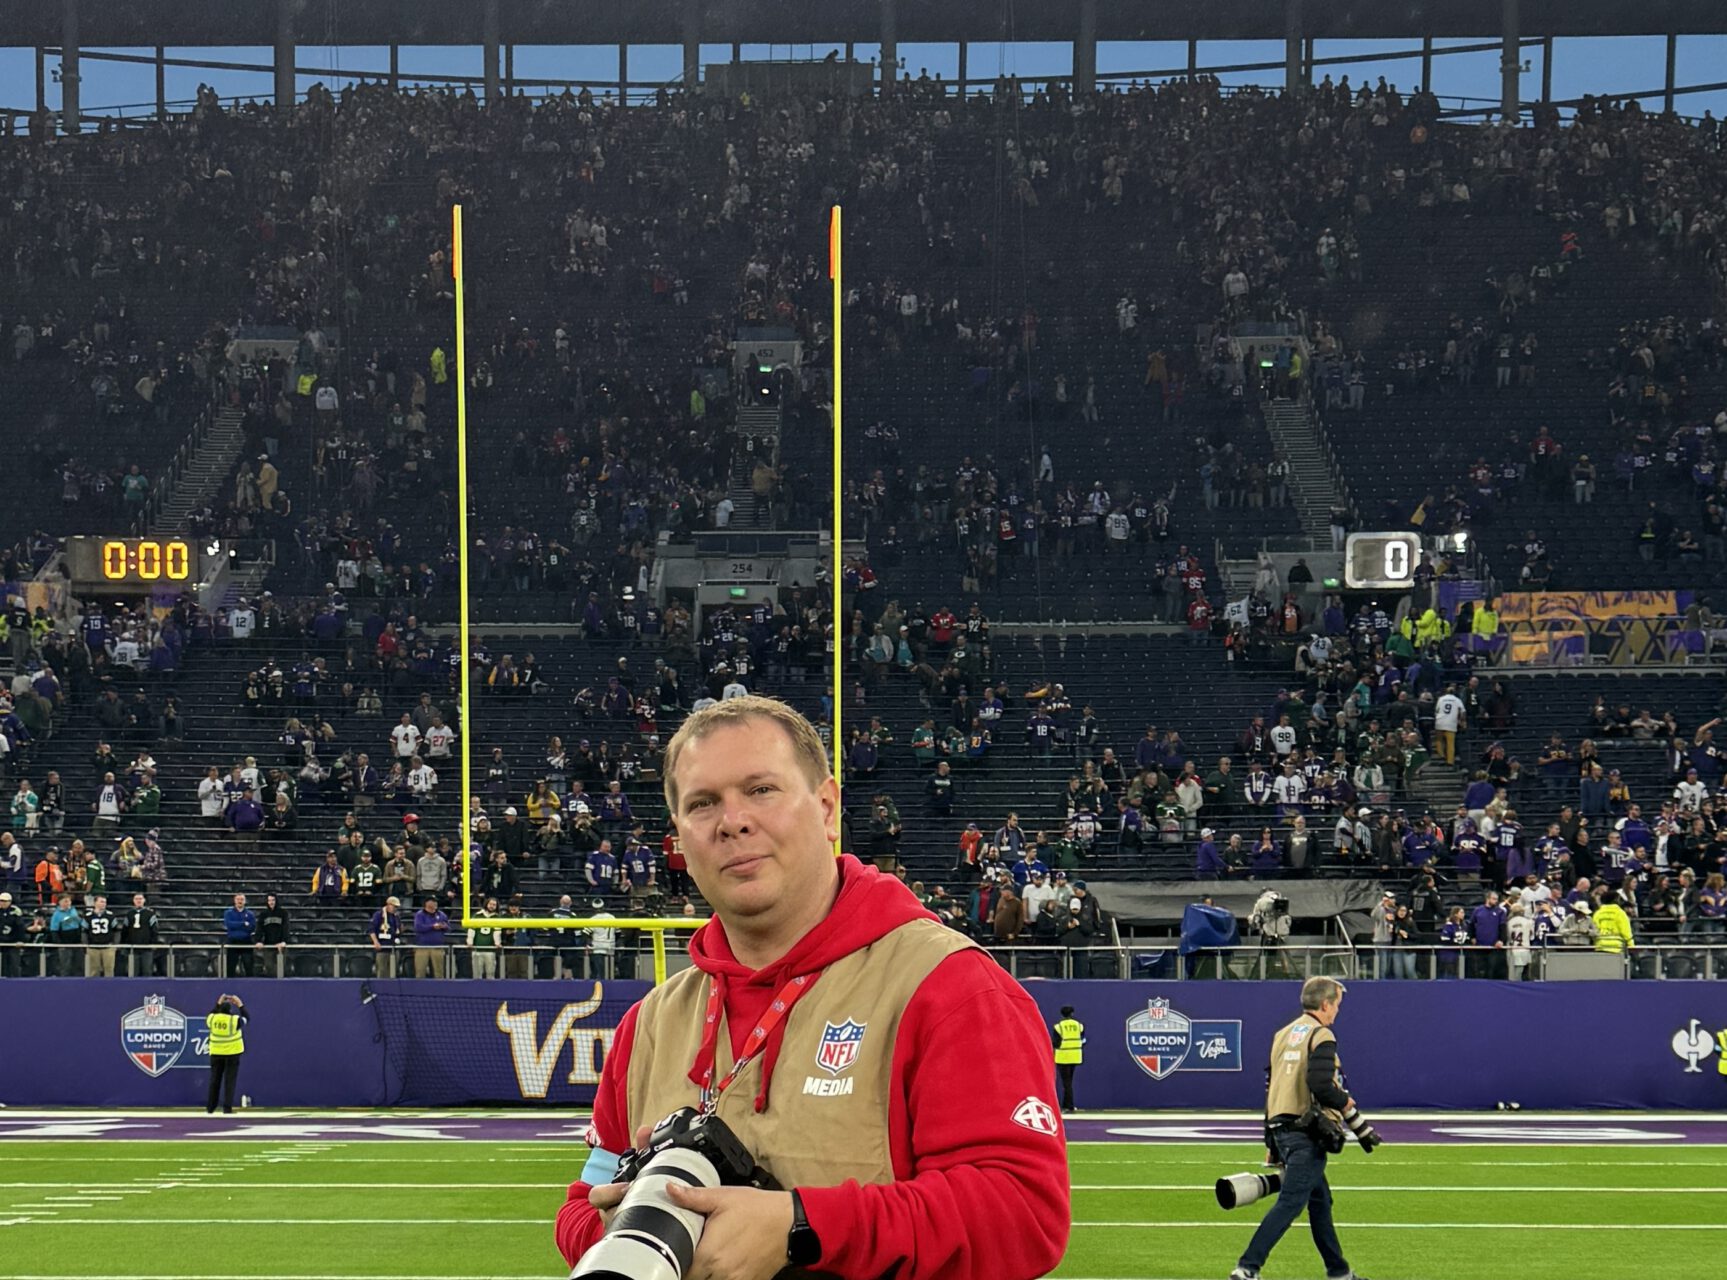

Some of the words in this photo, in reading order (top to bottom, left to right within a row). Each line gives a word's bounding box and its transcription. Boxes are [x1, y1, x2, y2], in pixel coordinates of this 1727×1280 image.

[757, 349, 773, 357] 452
[104, 541, 189, 580] 0:00
[1384, 541, 1409, 580] 0
[732, 563, 753, 574] 254
[1189, 577, 1202, 589] 95
[235, 617, 246, 628] 12
[968, 621, 981, 632] 92
[524, 669, 532, 682] 7
[1443, 703, 1452, 714] 9
[1037, 725, 1048, 736] 18
[403, 732, 409, 743] 4
[432, 736, 445, 747] 27
[102, 792, 114, 803] 18
[1689, 793, 1696, 805] 4
[1501, 832, 1514, 847] 18
[358, 872, 374, 887] 12
[91, 918, 109, 934] 53
[134, 913, 141, 928] 1
[127, 1033, 181, 1042] LONDON
[1131, 1036, 1186, 1045] LONDON
[821, 1042, 855, 1067] NFL
[802, 1076, 854, 1096] MEDIA
